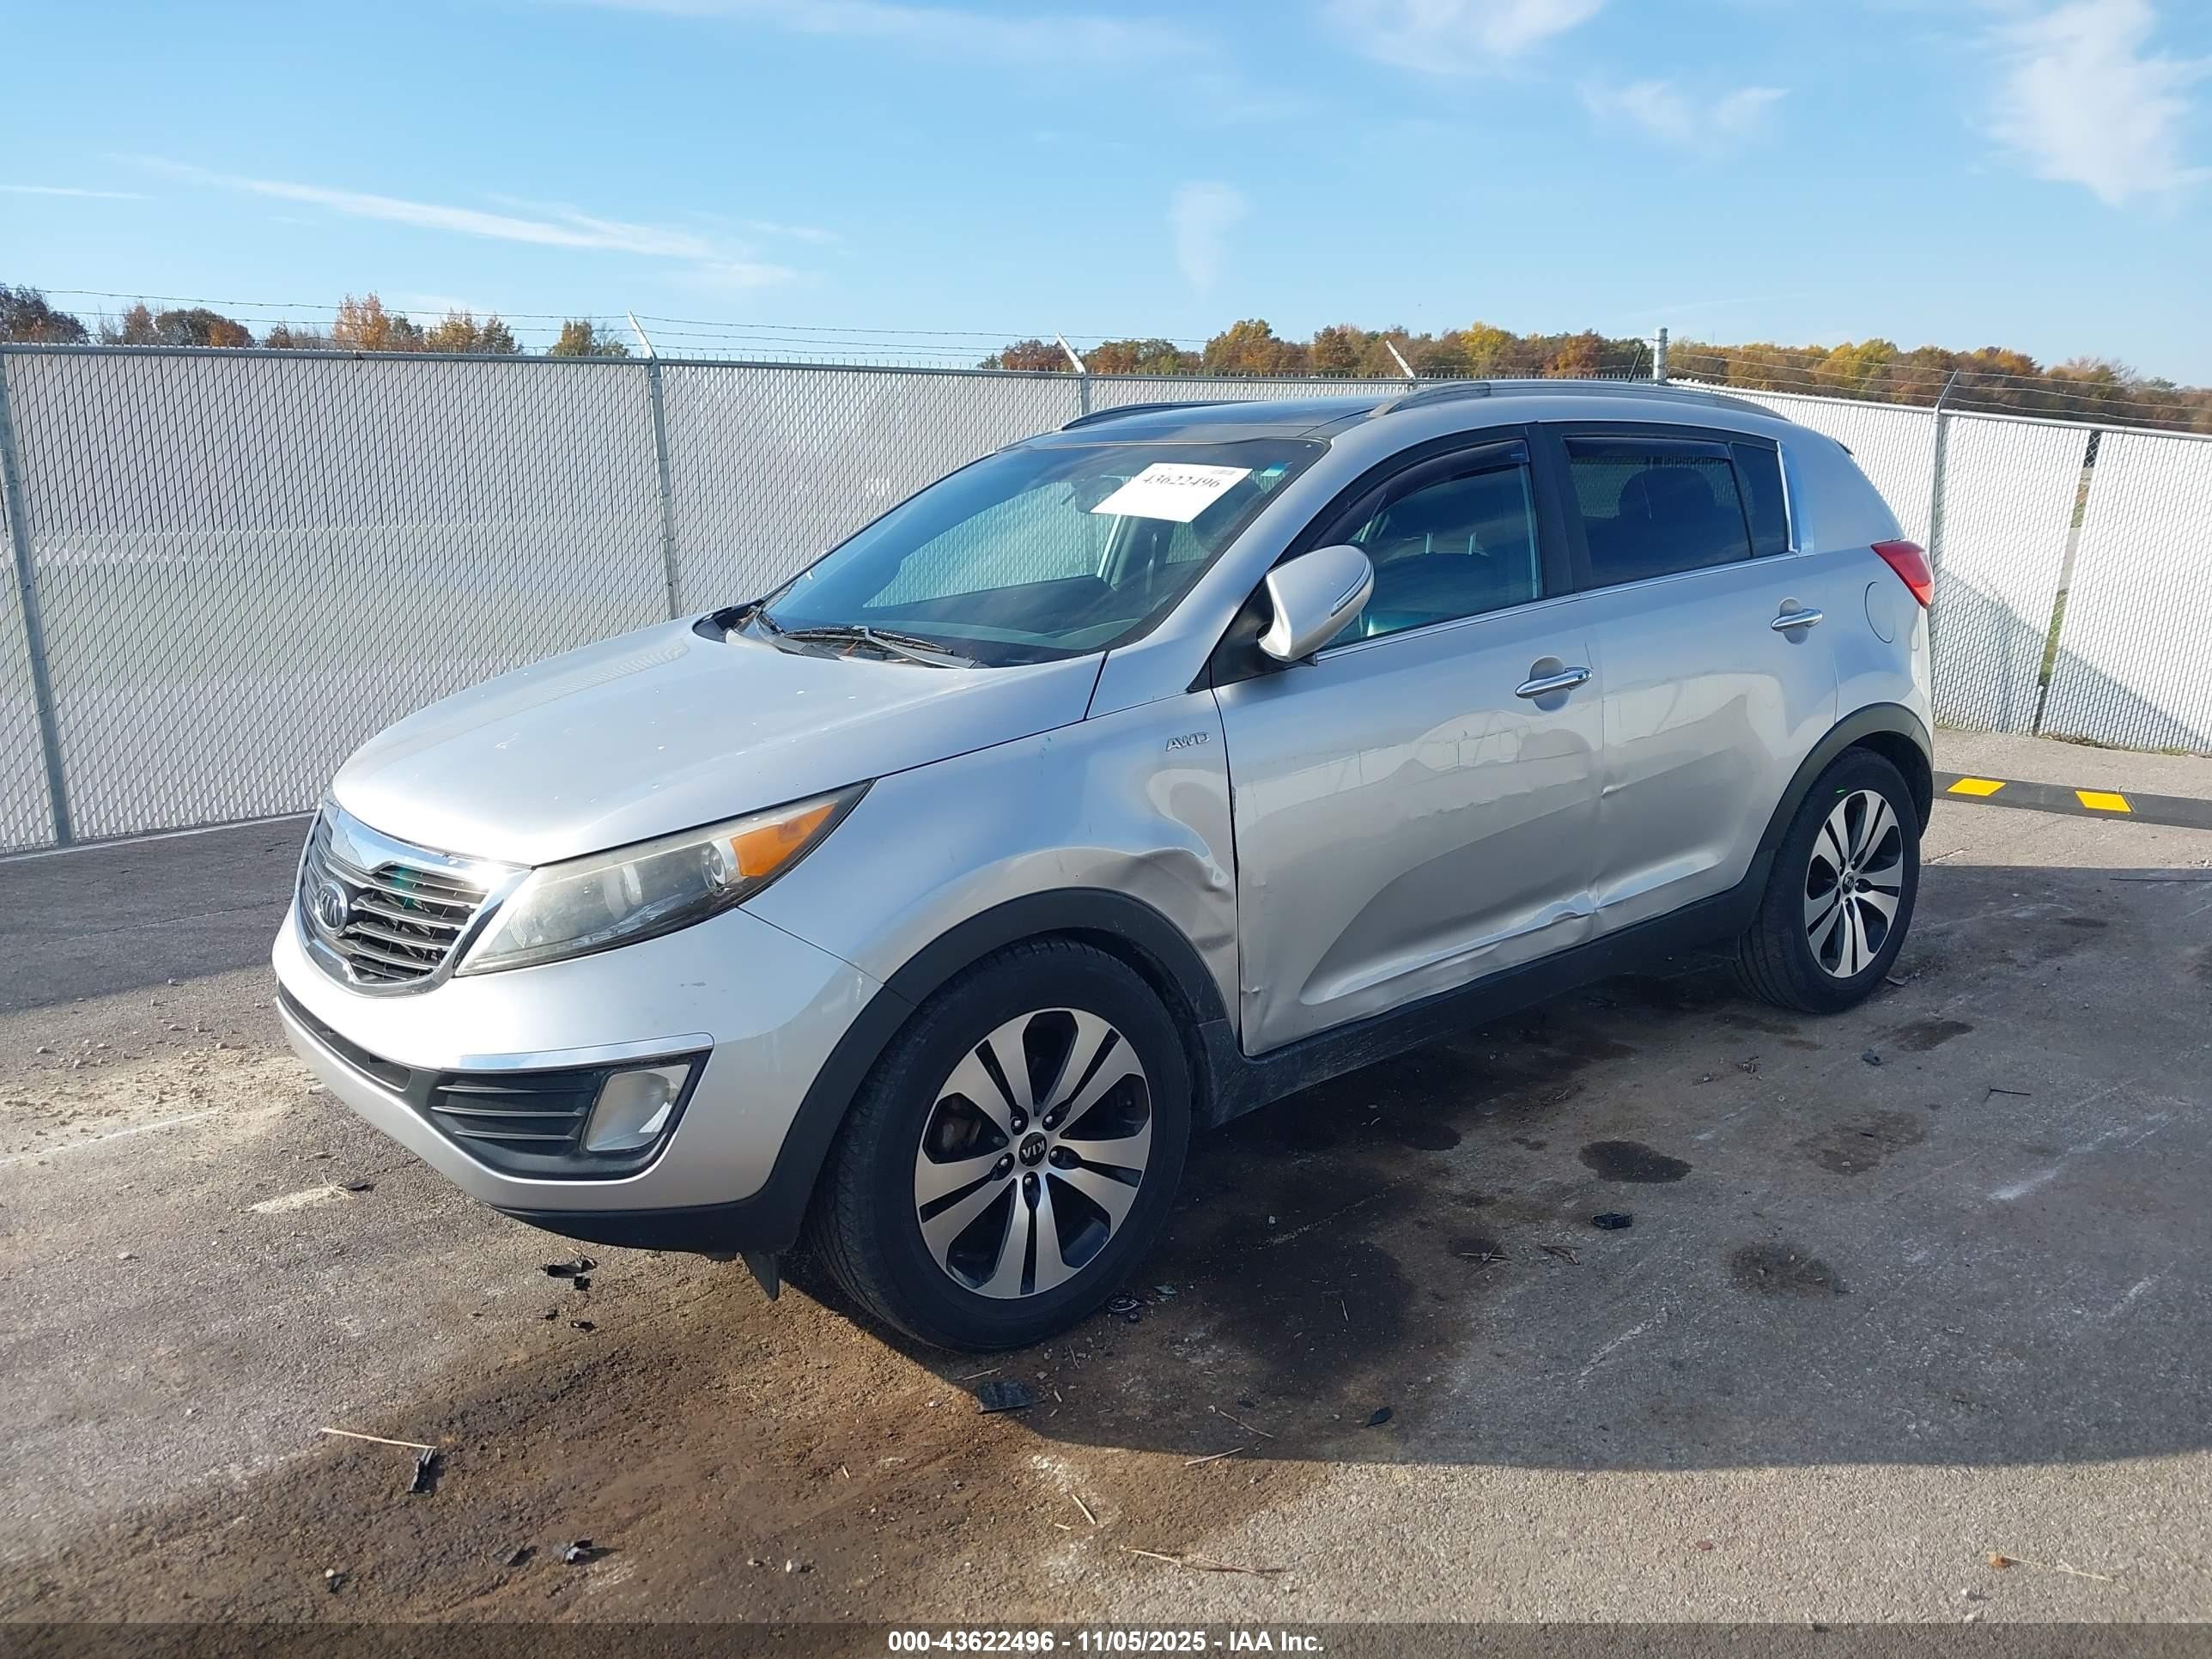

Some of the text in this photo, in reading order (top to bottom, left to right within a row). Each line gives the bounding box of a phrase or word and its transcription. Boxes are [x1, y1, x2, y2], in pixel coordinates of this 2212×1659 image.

[1142, 474, 1221, 489] 43622496
[1165, 732, 1210, 752] AWD
[1022, 1139, 1046, 1159] KIA
